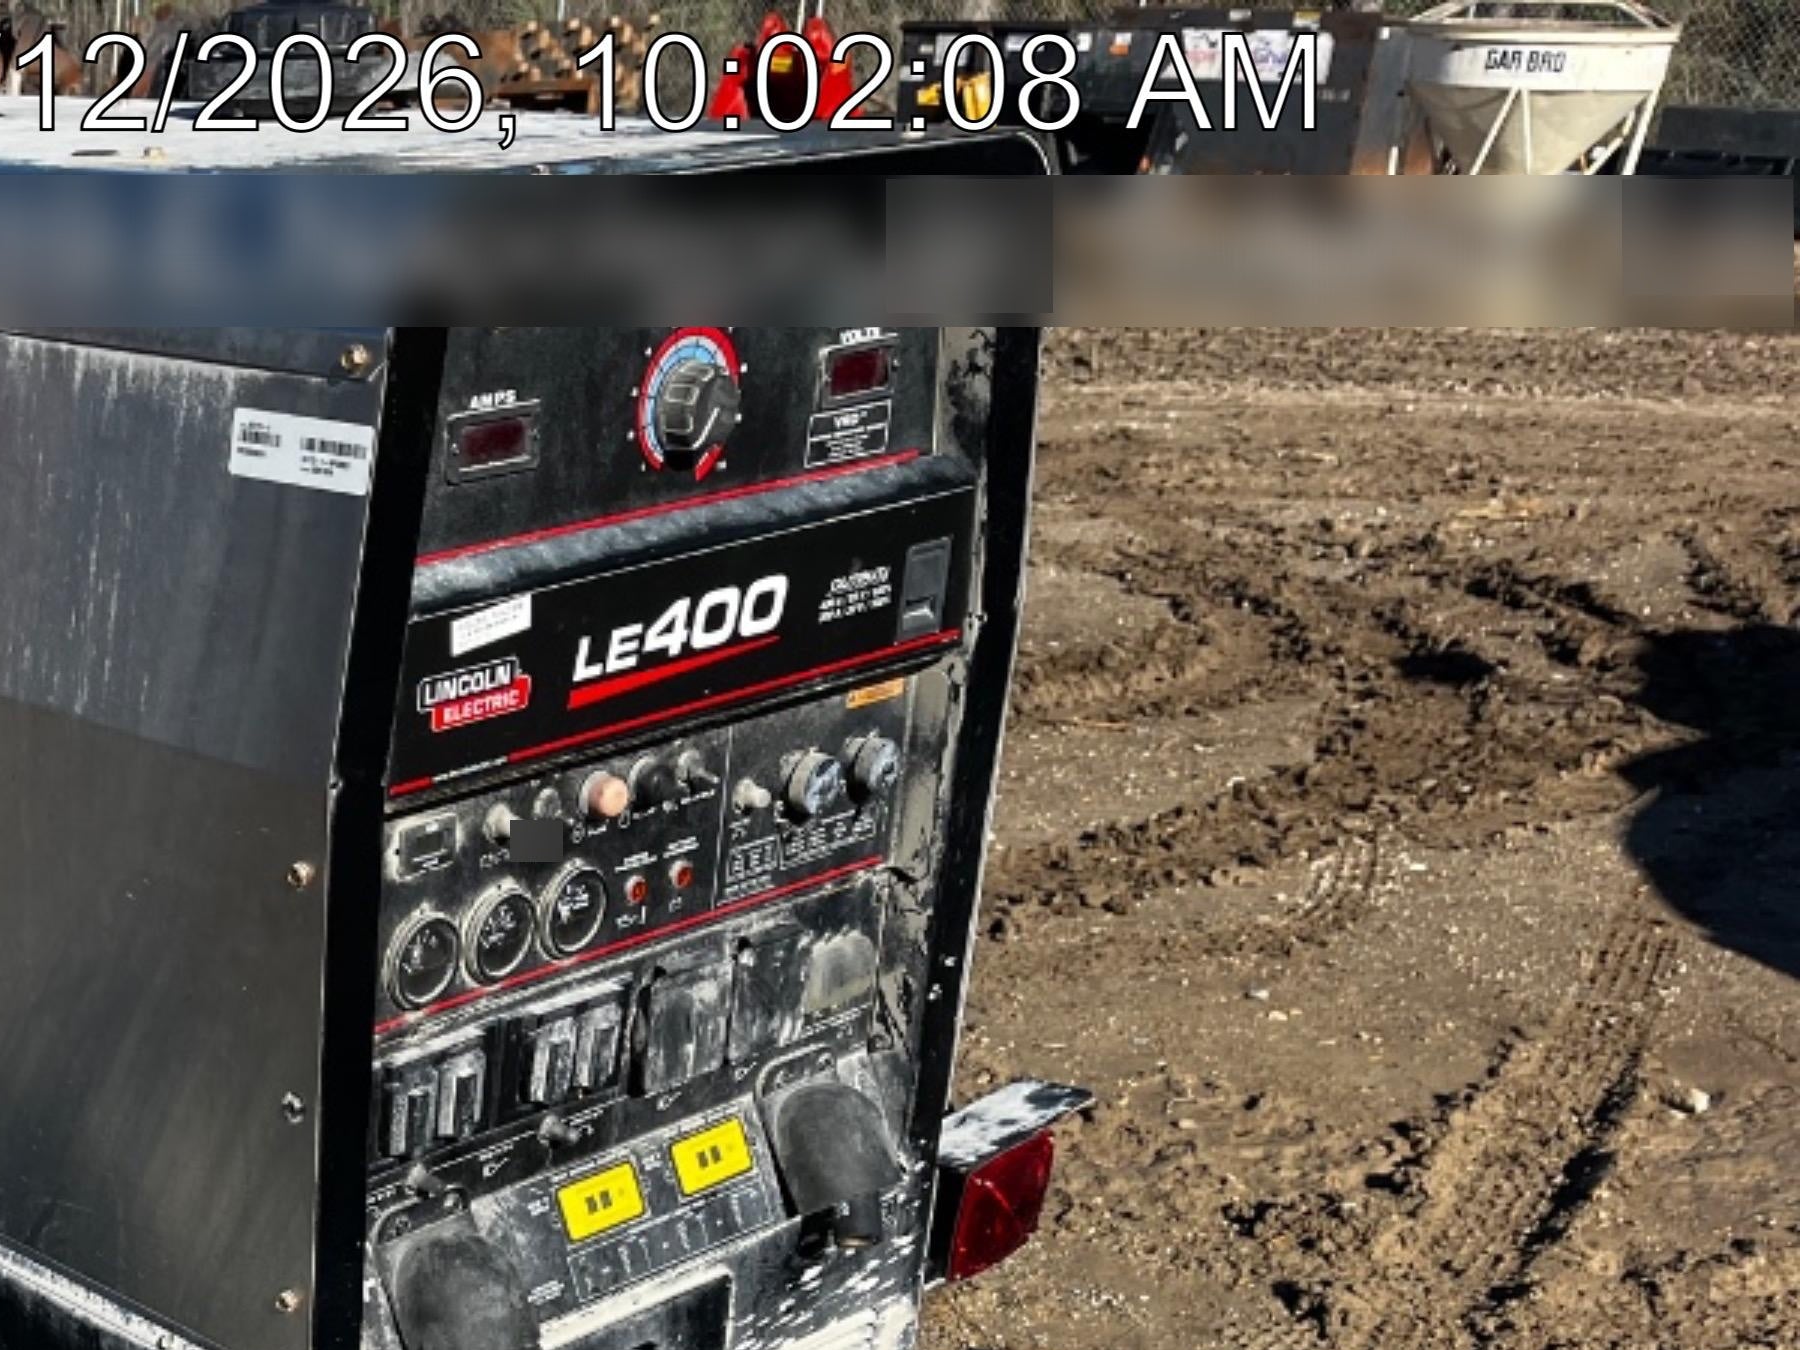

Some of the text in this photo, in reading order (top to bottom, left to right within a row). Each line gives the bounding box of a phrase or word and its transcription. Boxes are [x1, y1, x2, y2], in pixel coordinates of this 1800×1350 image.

[572, 573, 790, 682] LE400
[424, 663, 512, 706] LINCOLN
[442, 688, 520, 725] ELECTRIC
